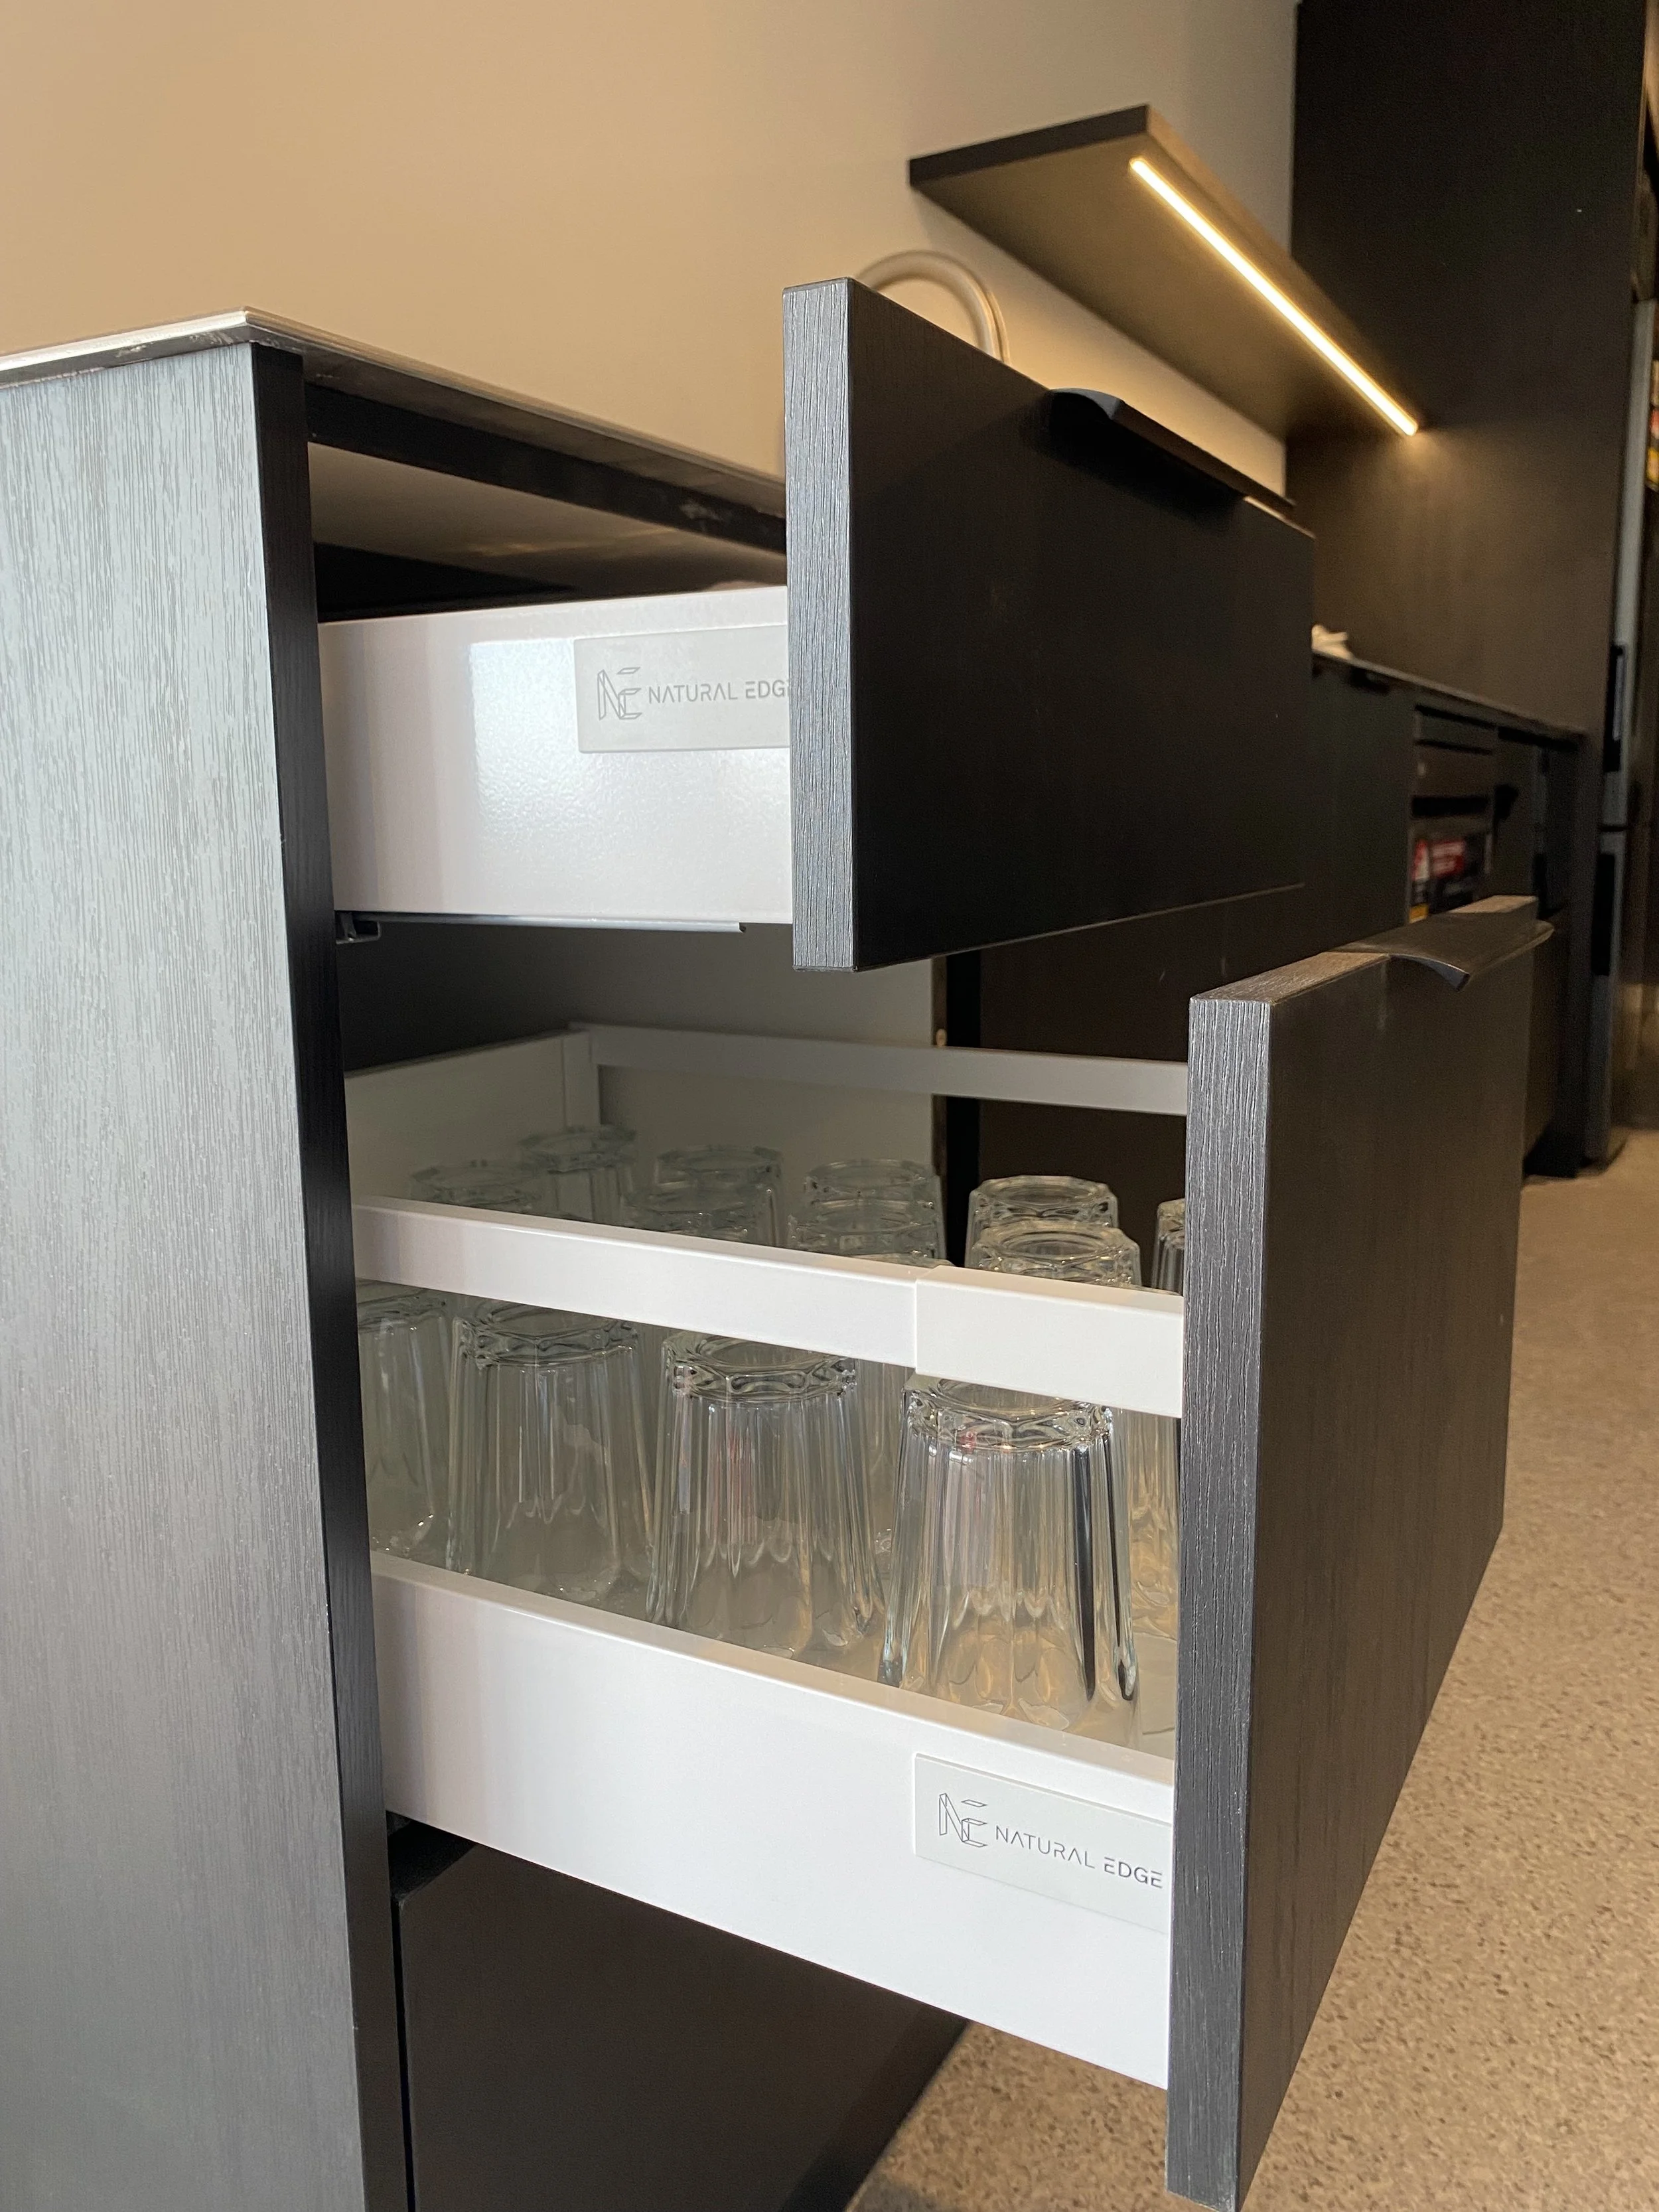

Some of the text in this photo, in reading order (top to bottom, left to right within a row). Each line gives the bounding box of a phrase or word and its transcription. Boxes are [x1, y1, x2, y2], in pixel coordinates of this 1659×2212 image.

[648, 682, 738, 704] NATURAL
[745, 679, 790, 700] EDG
[995, 1824, 1096, 1869] NATURAL
[1104, 1856, 1163, 1888] EDGE
